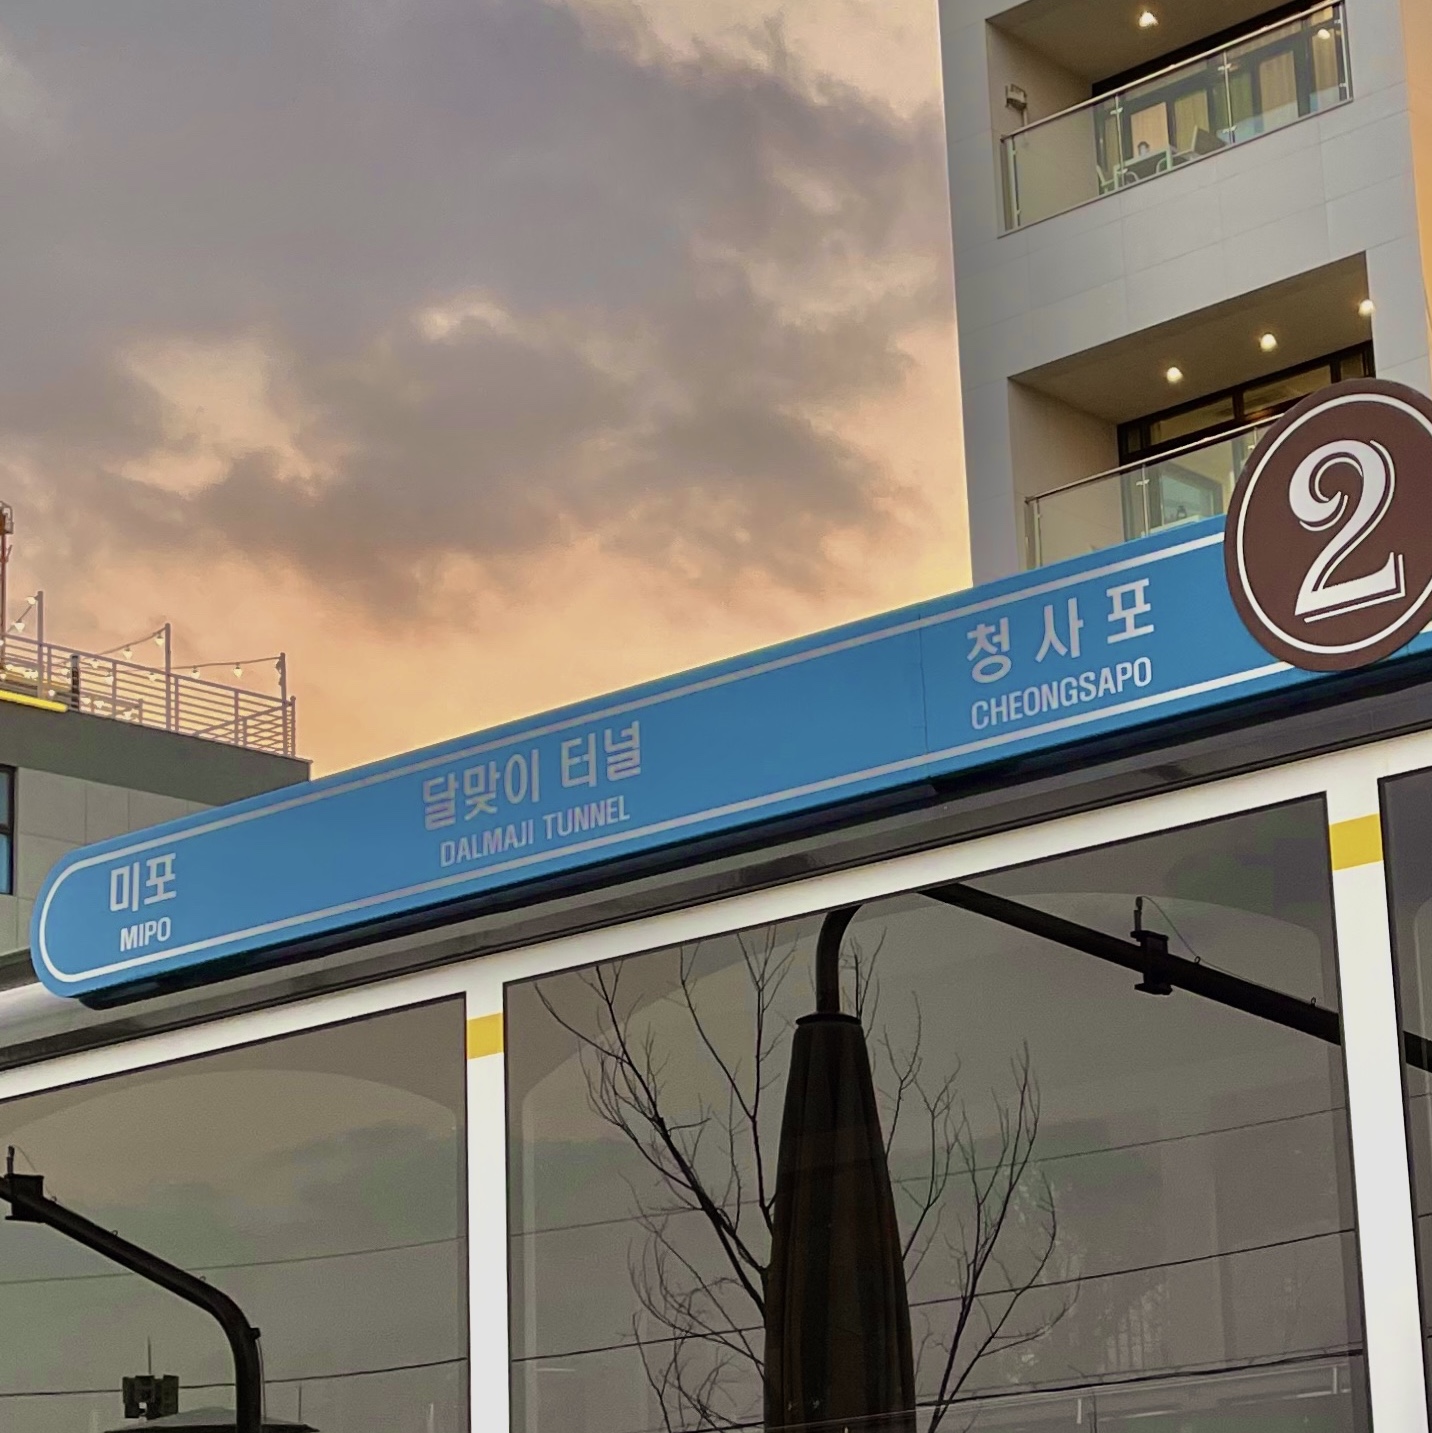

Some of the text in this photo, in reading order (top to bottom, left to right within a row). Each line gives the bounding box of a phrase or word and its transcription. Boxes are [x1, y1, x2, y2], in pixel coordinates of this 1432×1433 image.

[1288, 438, 1407, 624] 2
[970, 656, 1153, 731] CHEONGSAPO
[422, 720, 644, 831] 달맞이 터널
[439, 795, 631, 868] DALMAJI TUNNEL
[108, 851, 179, 914] 미포
[119, 916, 172, 953] MIPO
